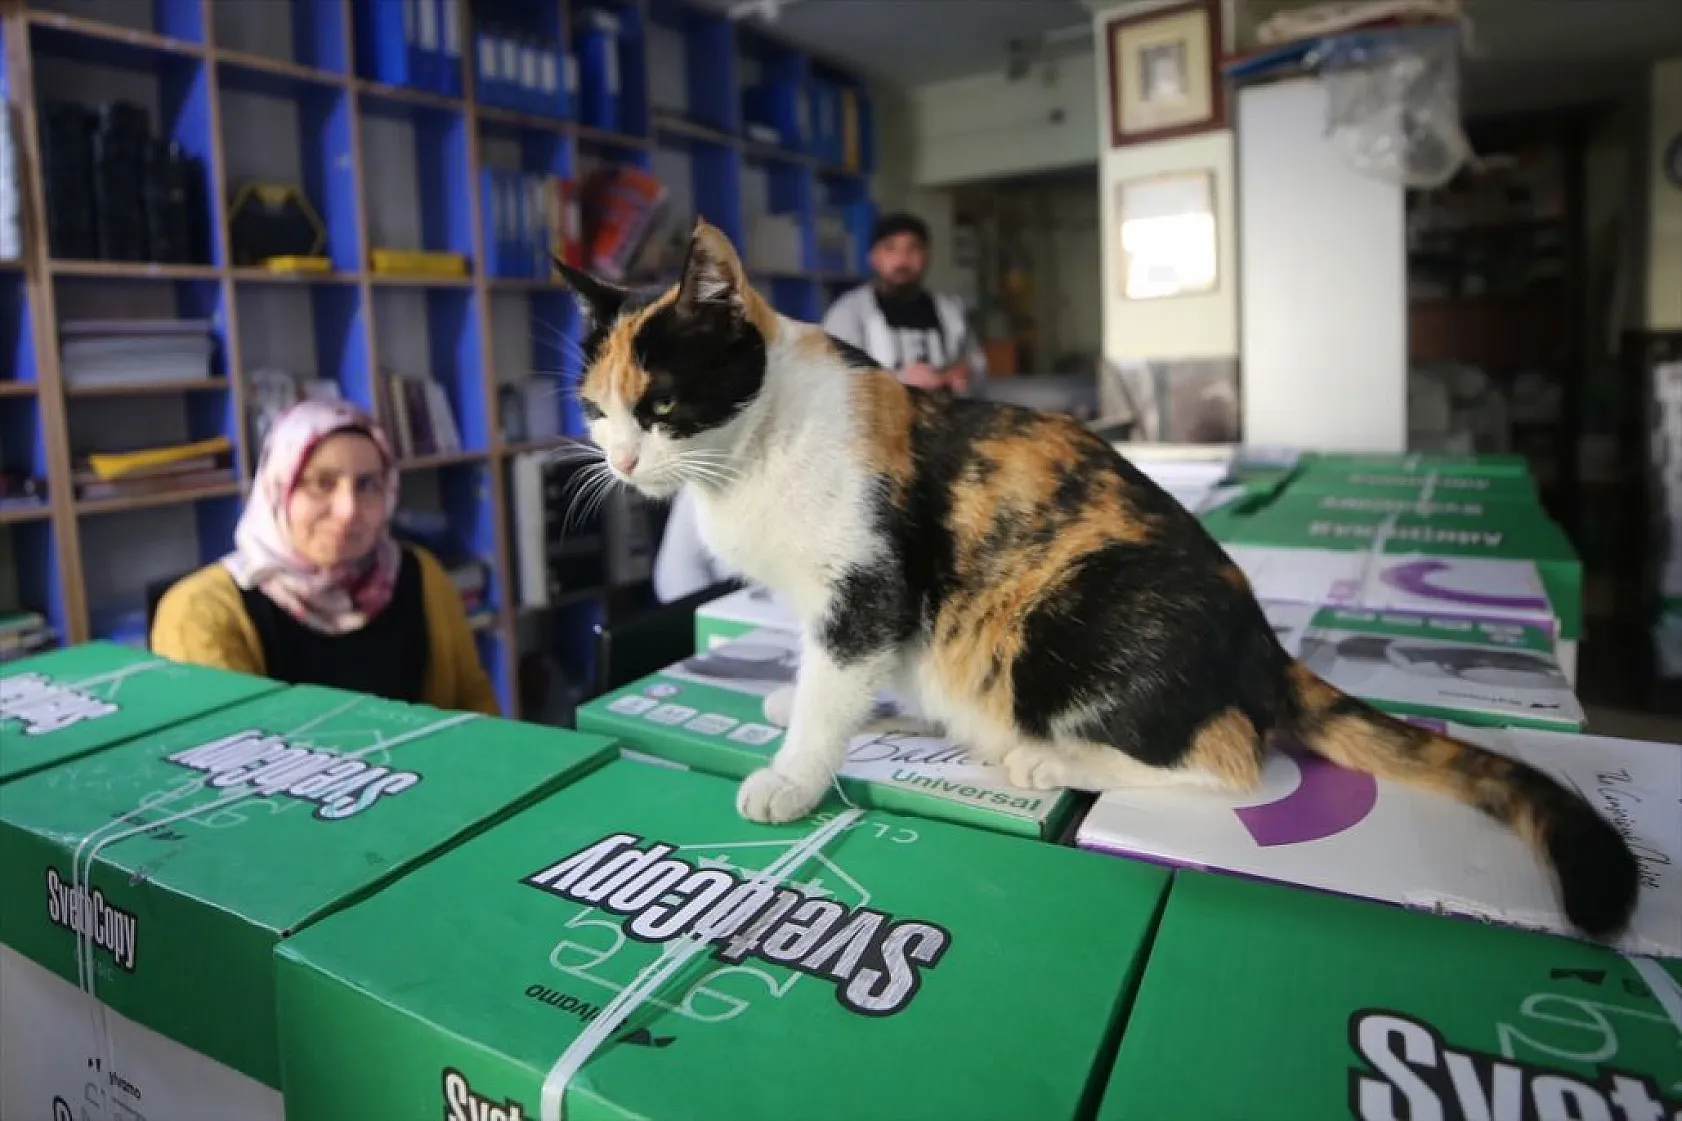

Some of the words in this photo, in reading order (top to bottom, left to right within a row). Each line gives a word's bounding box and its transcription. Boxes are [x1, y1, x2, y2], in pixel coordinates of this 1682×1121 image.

[891, 768, 1042, 811] Universal
[47, 867, 137, 972] SvetoCopy
[522, 833, 950, 1016] SvetoCopy
[1349, 1008, 1682, 1121] Svet
